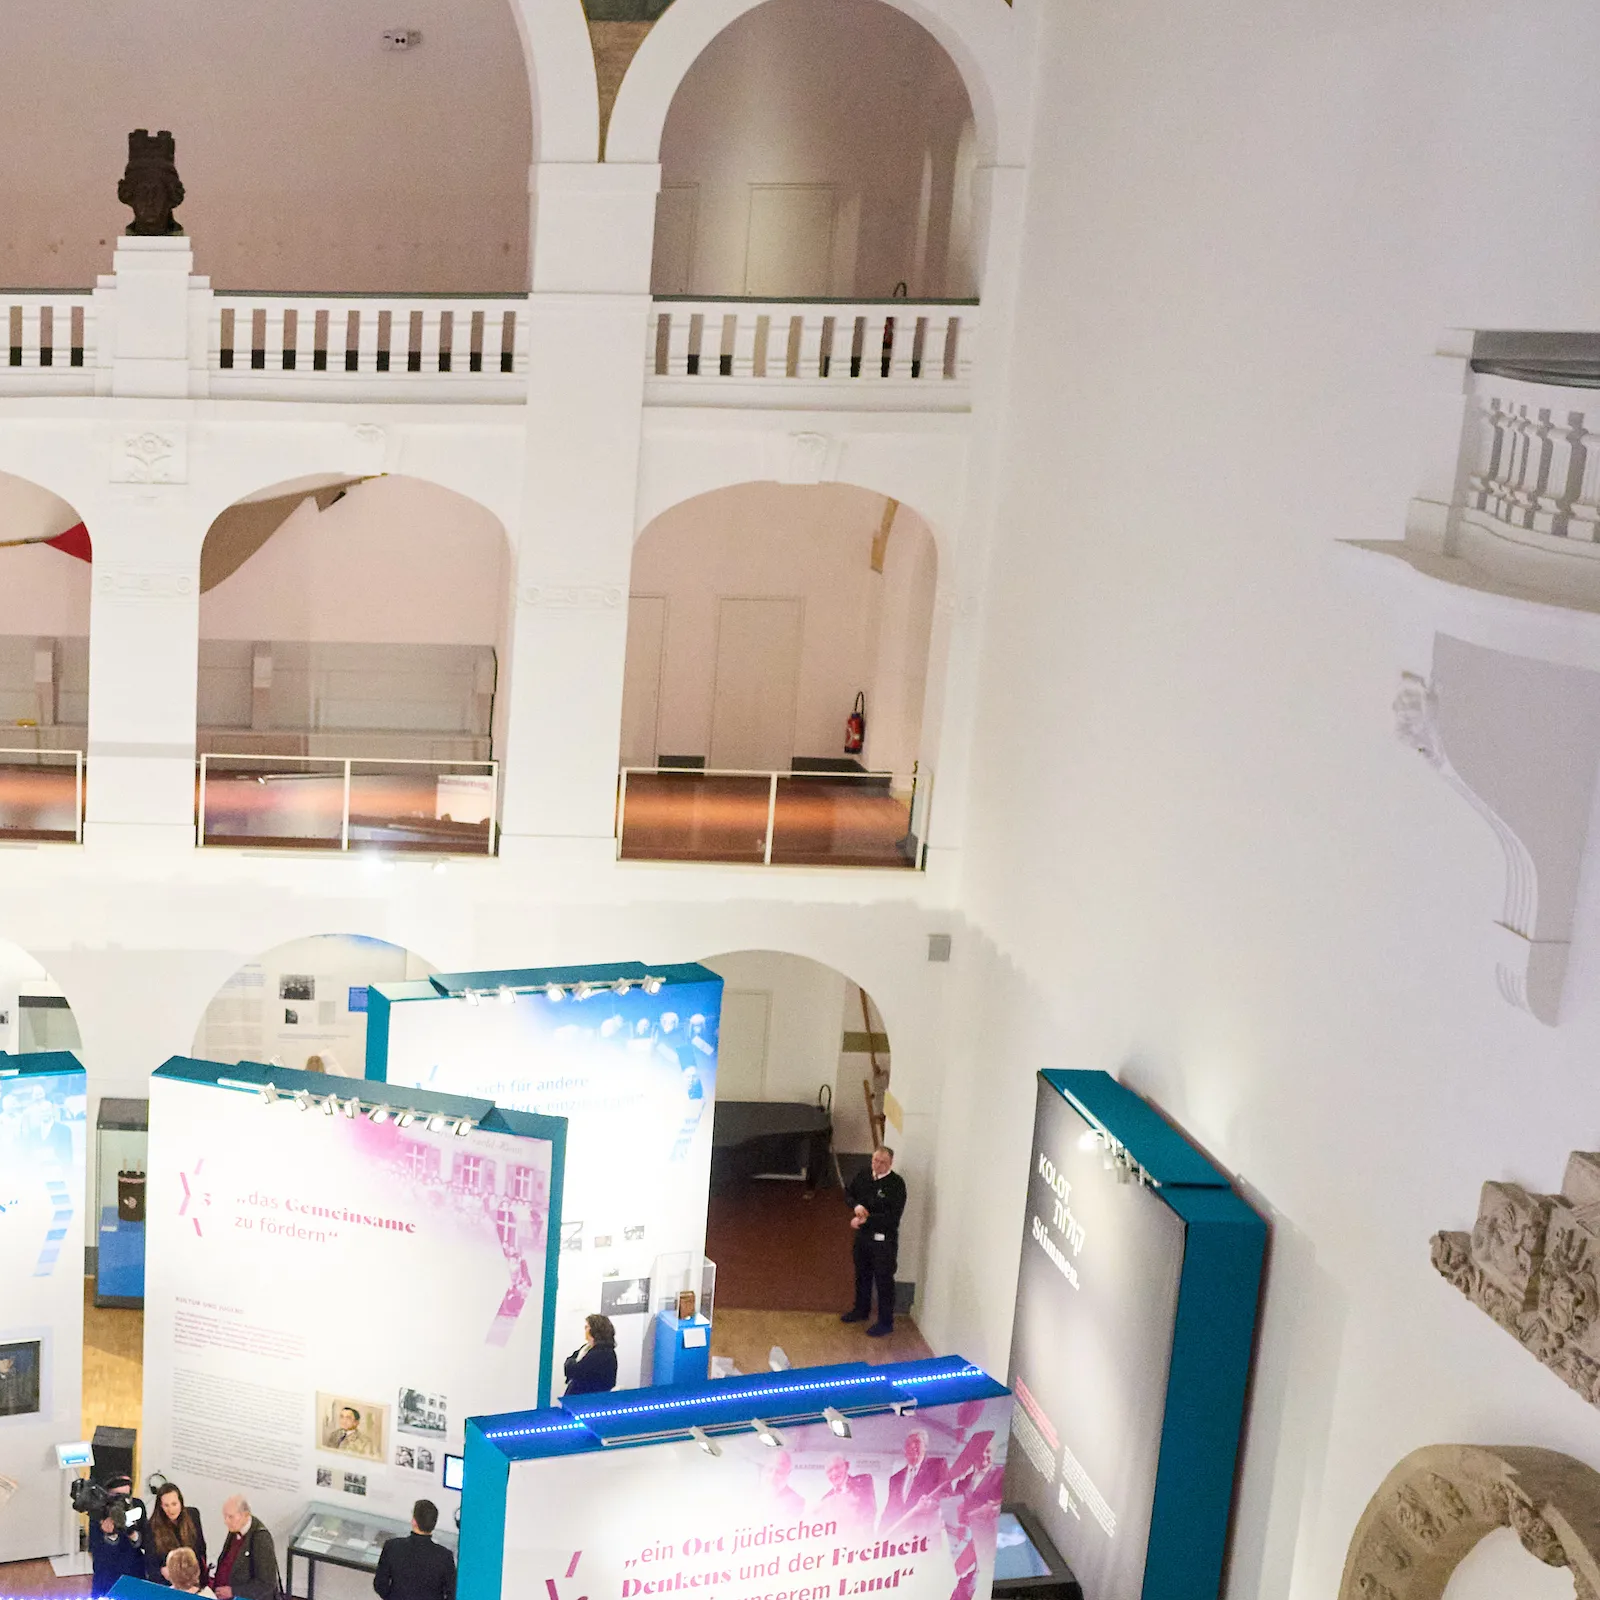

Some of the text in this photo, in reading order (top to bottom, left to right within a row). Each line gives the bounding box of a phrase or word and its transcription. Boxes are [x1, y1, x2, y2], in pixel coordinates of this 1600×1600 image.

[510, 1080, 531, 1092] für
[536, 1077, 590, 1091] andere
[1039, 1153, 1072, 1205] KOLOT
[235, 1216, 338, 1243] zu fördern“
[237, 1191, 416, 1233] „das Gemeinsame
[1033, 1216, 1080, 1291] Stimmen.
[621, 1534, 930, 1598] Denkens und der Freiheit
[624, 1519, 837, 1569] „ein Ort jüdischen
[838, 1566, 916, 1597] Land“
